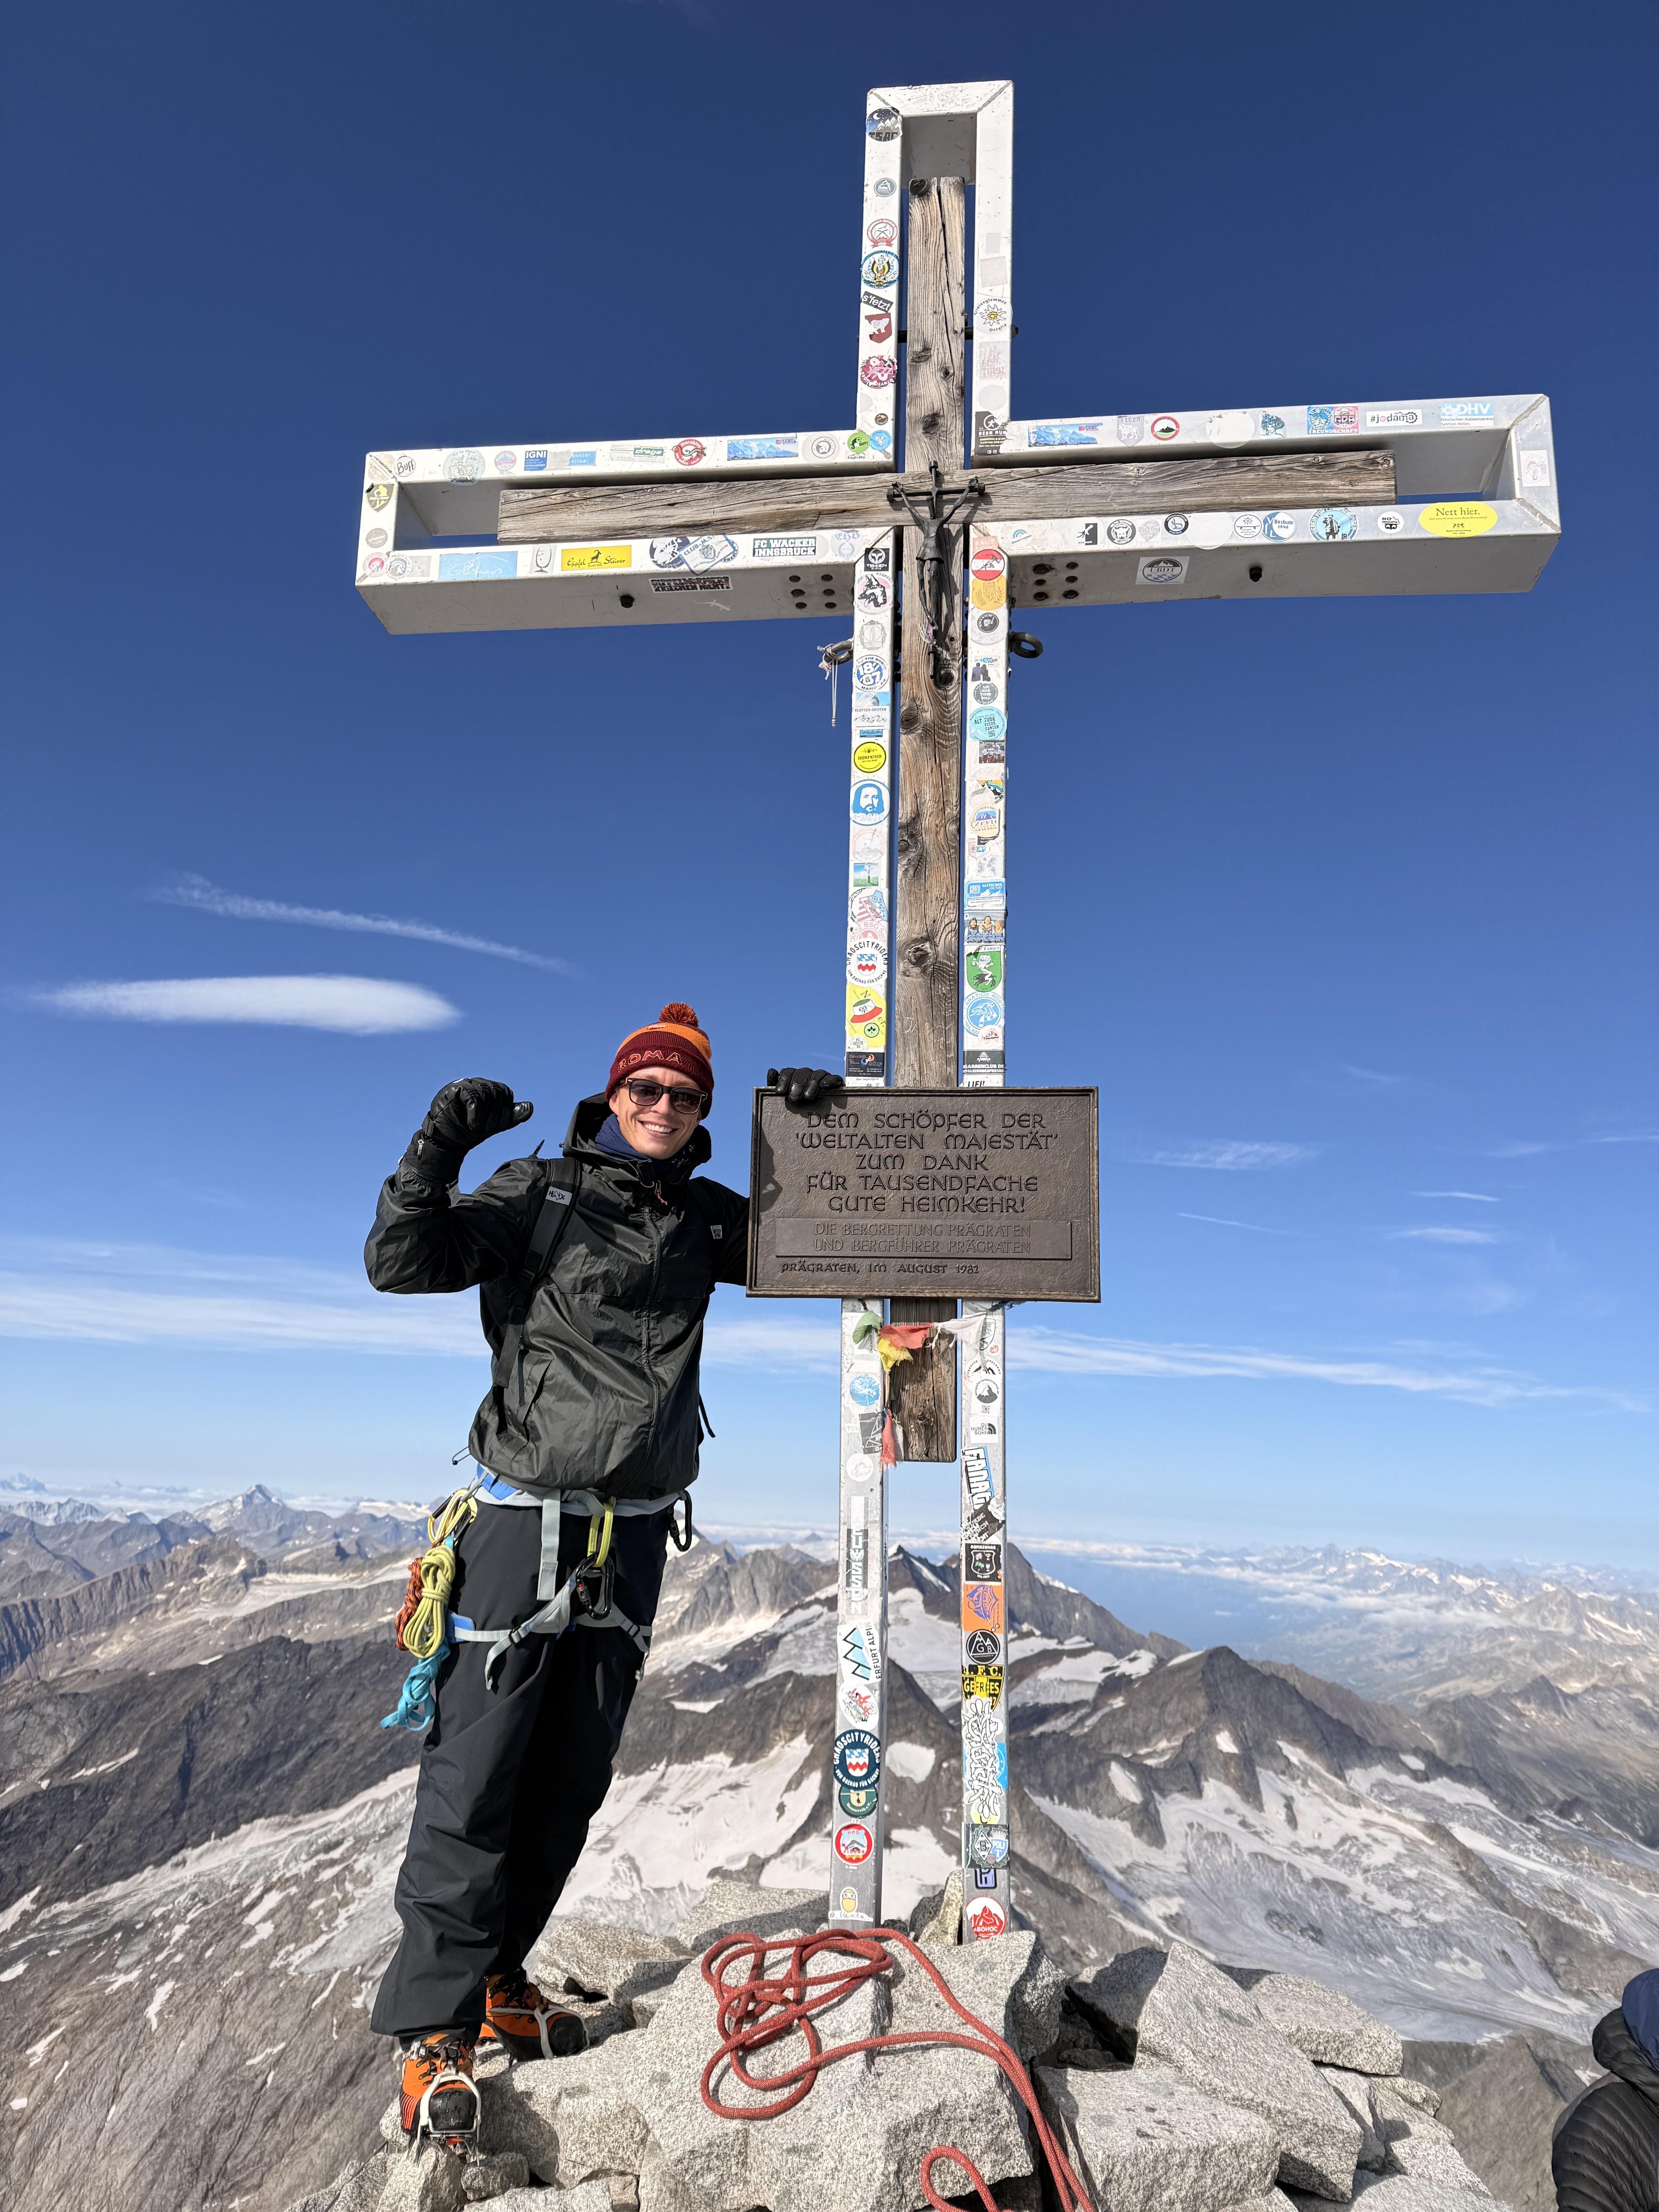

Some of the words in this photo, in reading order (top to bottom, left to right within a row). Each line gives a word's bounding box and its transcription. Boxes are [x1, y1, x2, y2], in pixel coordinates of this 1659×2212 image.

[862, 295, 891, 311] s'fetzt
[1457, 404, 1491, 415] DHV
[525, 450, 547, 459] IGNI
[754, 547, 815, 556] INNSBRUCK
[755, 540, 767, 548] FC
[770, 539, 816, 547] WACKER
[618, 1049, 682, 1073] ROMA
[808, 1112, 858, 1128] DEM
[874, 1109, 986, 1132] SCHÖPFER
[1002, 1112, 1044, 1128] DER
[856, 1154, 904, 1170] ZUM
[923, 1155, 988, 1170] DANK
[807, 1170, 848, 1193] FÜR
[859, 1175, 1038, 1192] TAUSENDFACHE
[828, 1196, 885, 1212] GUTE
[902, 1196, 1025, 1213] HEIMKEHR!
[815, 1223, 836, 1235] DIE
[843, 1223, 943, 1236] BERGRETTUNG
[948, 1221, 1030, 1237] PRÄGRATEN
[814, 1239, 843, 1251] UND
[853, 1238, 939, 1253] BERGFÜHRER
[948, 1238, 1030, 1254] PRÄGRATEN
[781, 1260, 860, 1274] PRÄGRATEN,
[868, 1263, 887, 1273] IM
[898, 1264, 947, 1273] AUGUST
[955, 1264, 979, 1274] 1982
[869, 1648, 882, 1680] ERFURT
[964, 1681, 999, 1693] GEFREES
[833, 1732, 881, 1765] CHAOSCITYRIDERS
[842, 1778, 859, 1788] DACHAU
